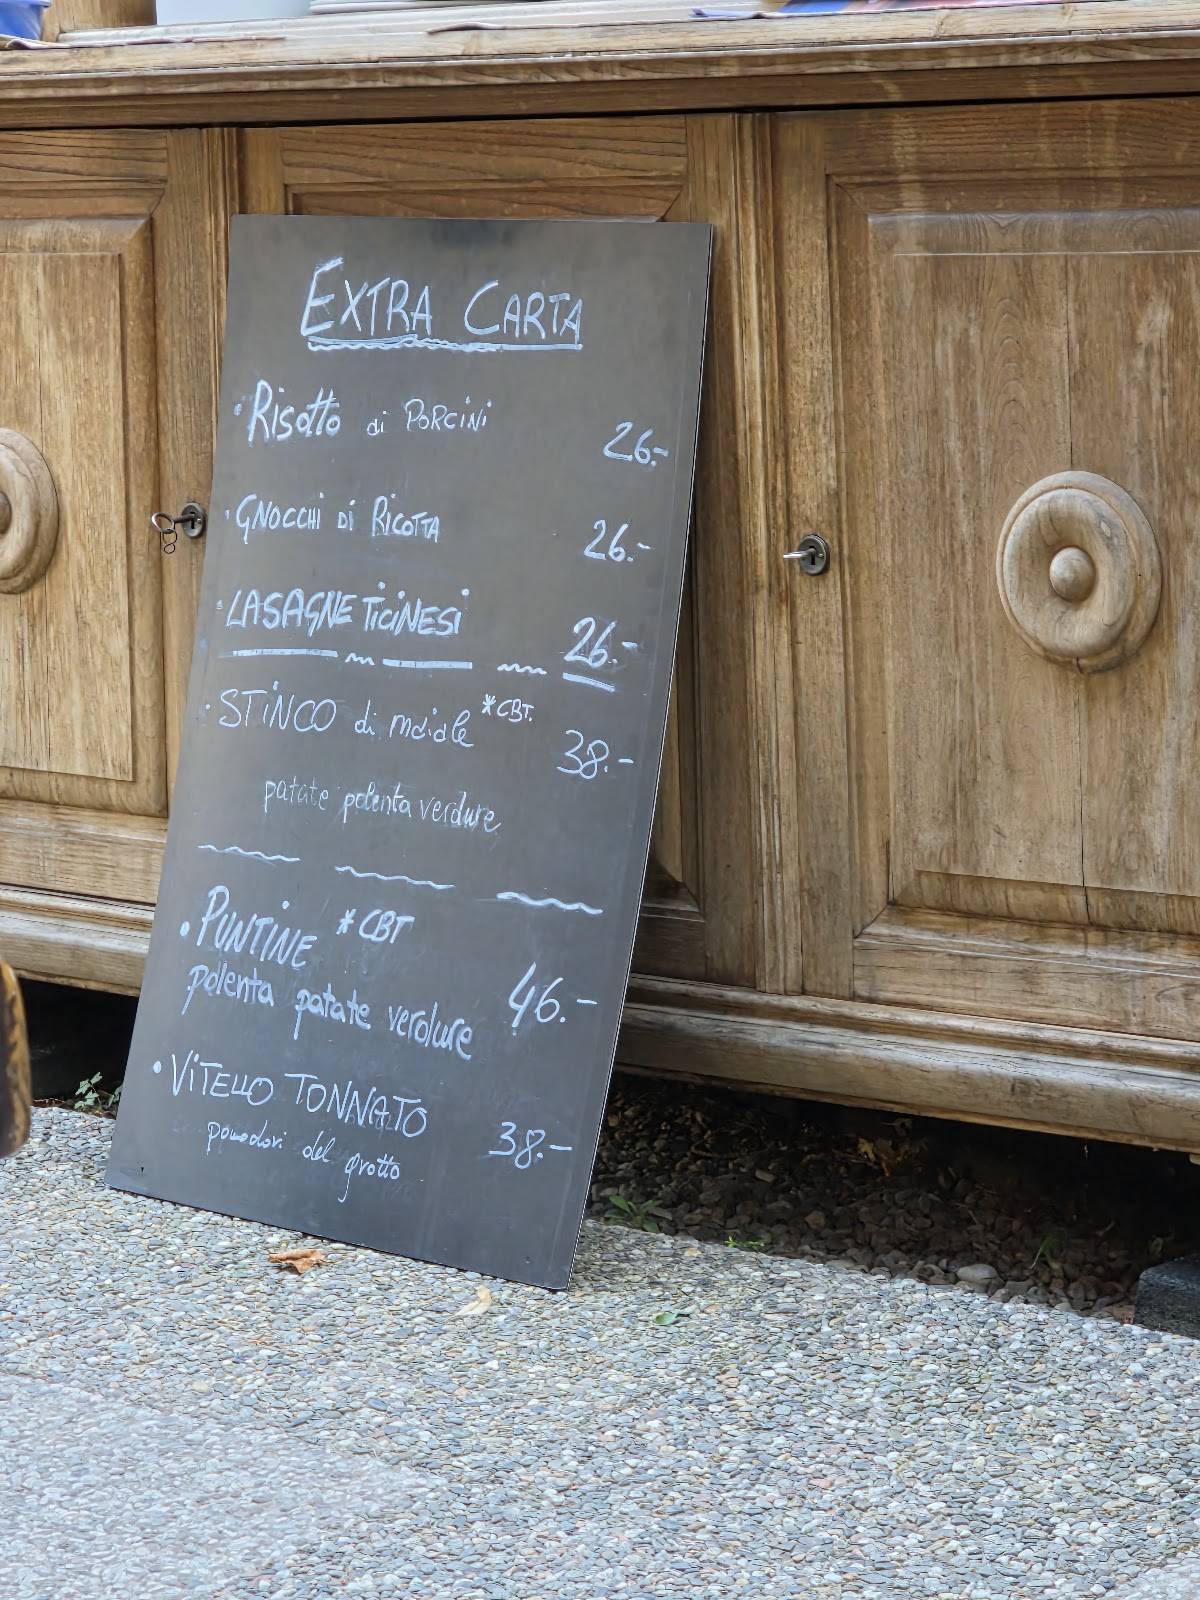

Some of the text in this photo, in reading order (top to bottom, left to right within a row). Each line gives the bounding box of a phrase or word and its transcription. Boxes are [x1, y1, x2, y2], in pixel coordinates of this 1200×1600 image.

[248, 380, 341, 442] Risotto
[367, 410, 388, 436] di
[226, 588, 357, 637] LASAGNE
[355, 700, 375, 737] di
[390, 708, 474, 747] maiale
[265, 776, 501, 832] patate polenta verdure
[182, 961, 473, 1060] polenta patate verdure
[285, 1073, 427, 1137] TONNATO
[207, 1120, 400, 1203] pomodori del grotto
